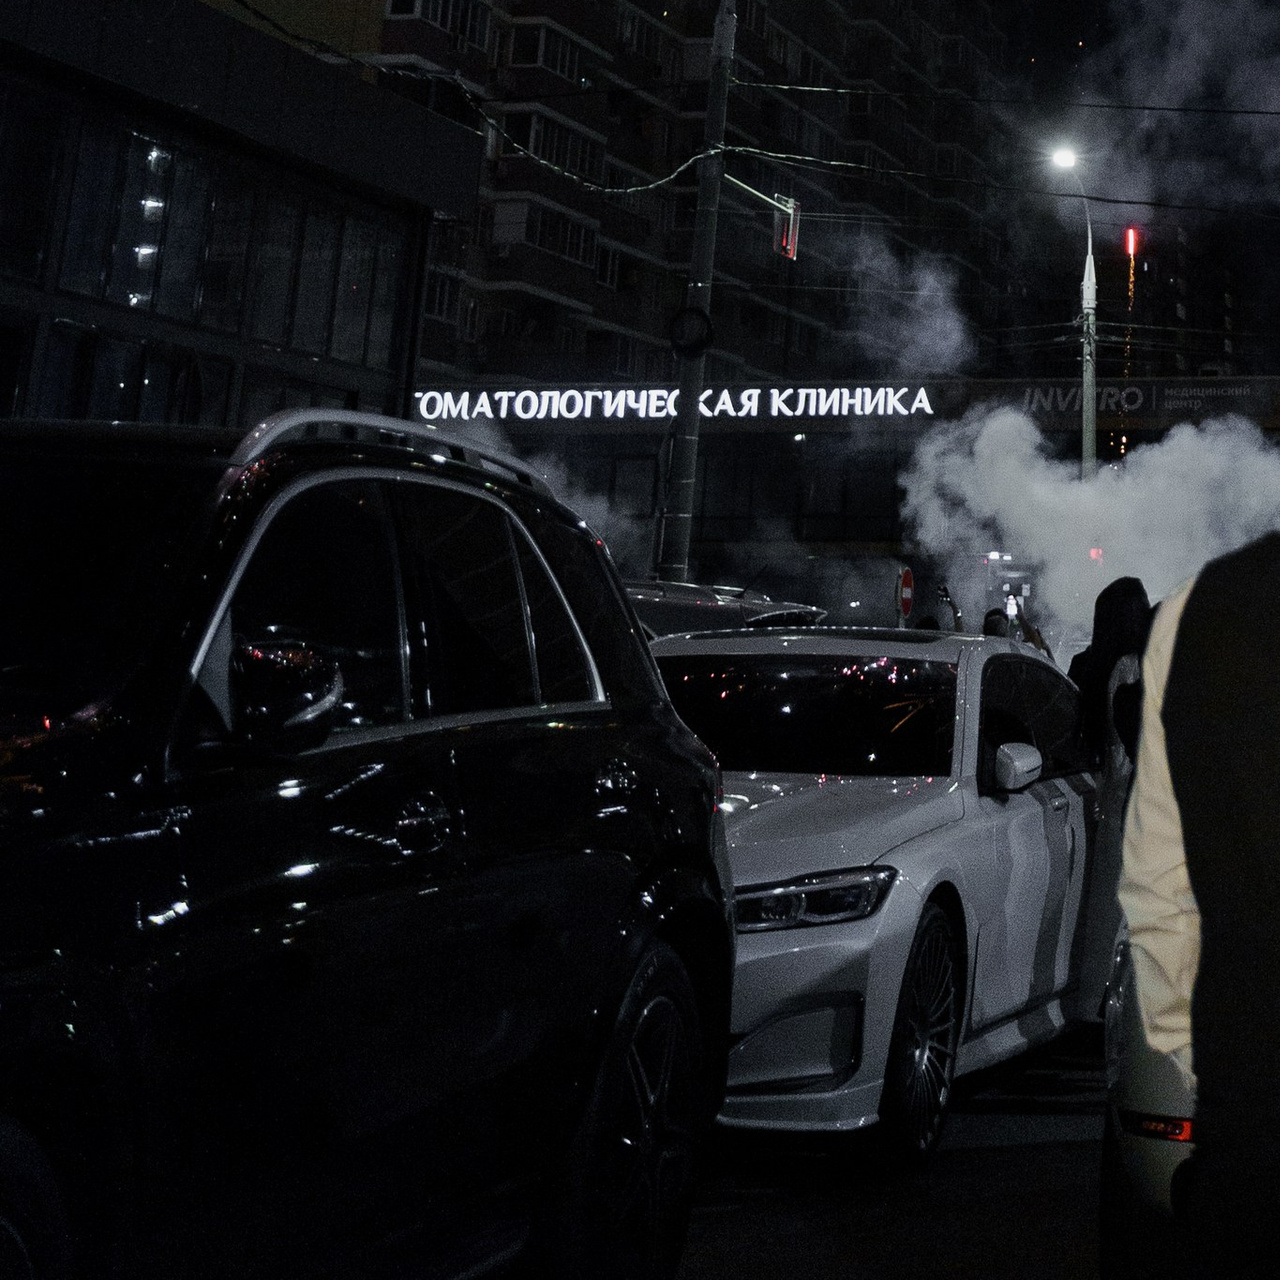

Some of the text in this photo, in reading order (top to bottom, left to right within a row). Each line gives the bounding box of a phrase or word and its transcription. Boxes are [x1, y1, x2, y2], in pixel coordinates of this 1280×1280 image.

[1164, 385, 1251, 399] медицинский
[770, 387, 934, 416] КЛИНИКА
[1164, 401, 1203, 411] центр
